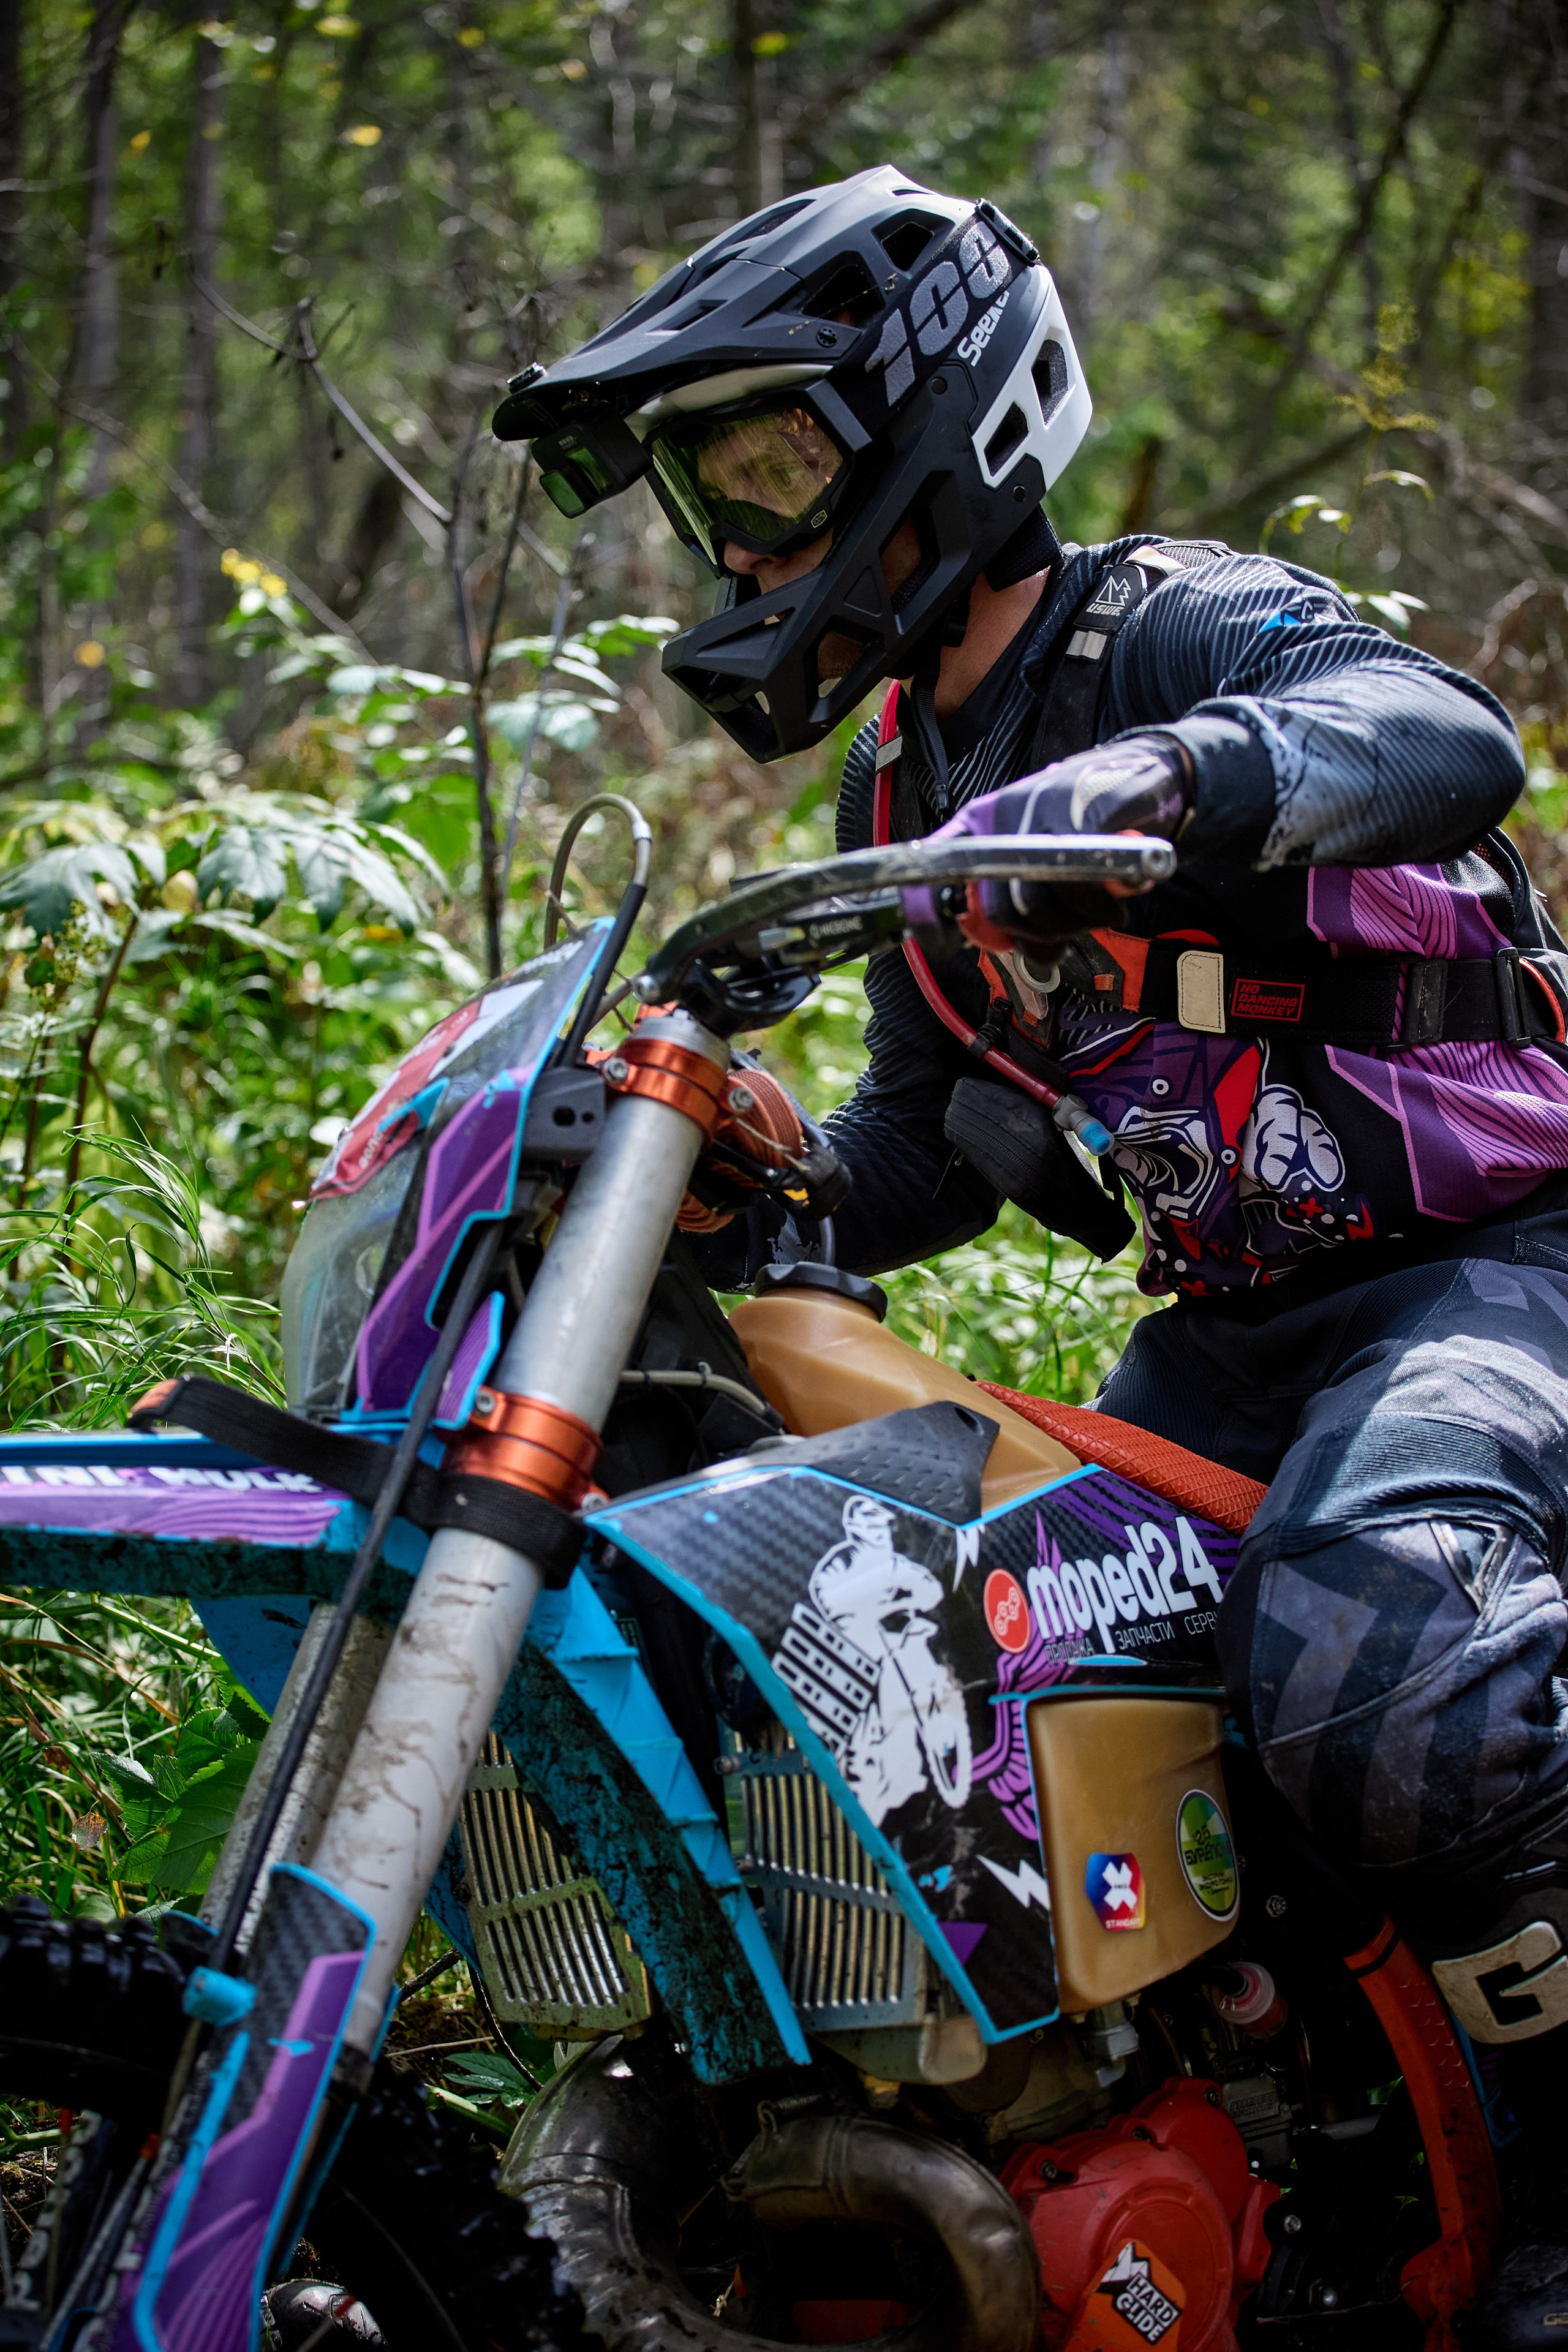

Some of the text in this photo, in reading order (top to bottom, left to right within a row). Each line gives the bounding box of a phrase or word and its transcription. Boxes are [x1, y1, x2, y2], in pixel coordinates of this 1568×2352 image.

[1085, 604, 1125, 616] USWE
[1238, 995, 1298, 1006] DANCING
[1241, 984, 1259, 993] NO
[1237, 1003, 1295, 1016] MONKEY
[1027, 1516, 1224, 1654] moped24
[1115, 1621, 1175, 1651] ЗАПЧАСТИ
[1184, 1610, 1217, 1635] СЕРВ
[1130, 2278, 1175, 2323] HARD
[1116, 2292, 1164, 2342] GLIDE
